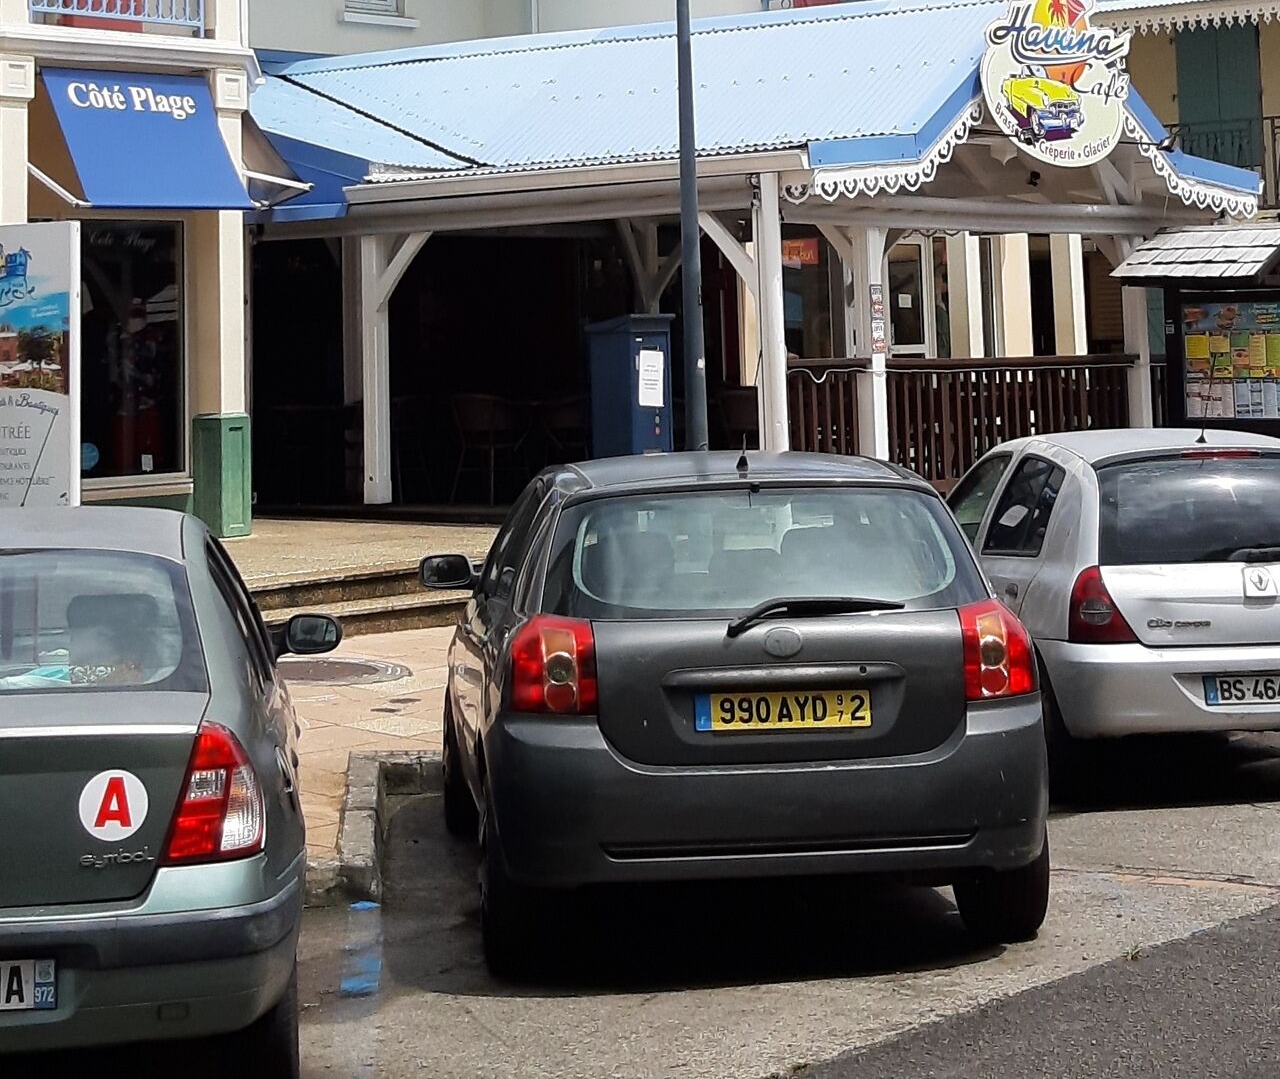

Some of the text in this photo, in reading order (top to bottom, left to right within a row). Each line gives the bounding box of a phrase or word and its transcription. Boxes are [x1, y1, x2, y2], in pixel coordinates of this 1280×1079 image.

[989, 2, 1126, 62] Havana
[68, 82, 196, 120] Côté Plage
[1071, 63, 1128, 105] Café
[1083, 134, 1111, 158] Glacier
[720, 696, 771, 724] 990
[777, 695, 828, 723] AYD
[94, 776, 132, 827] A
[34, 986, 55, 1003] 972
